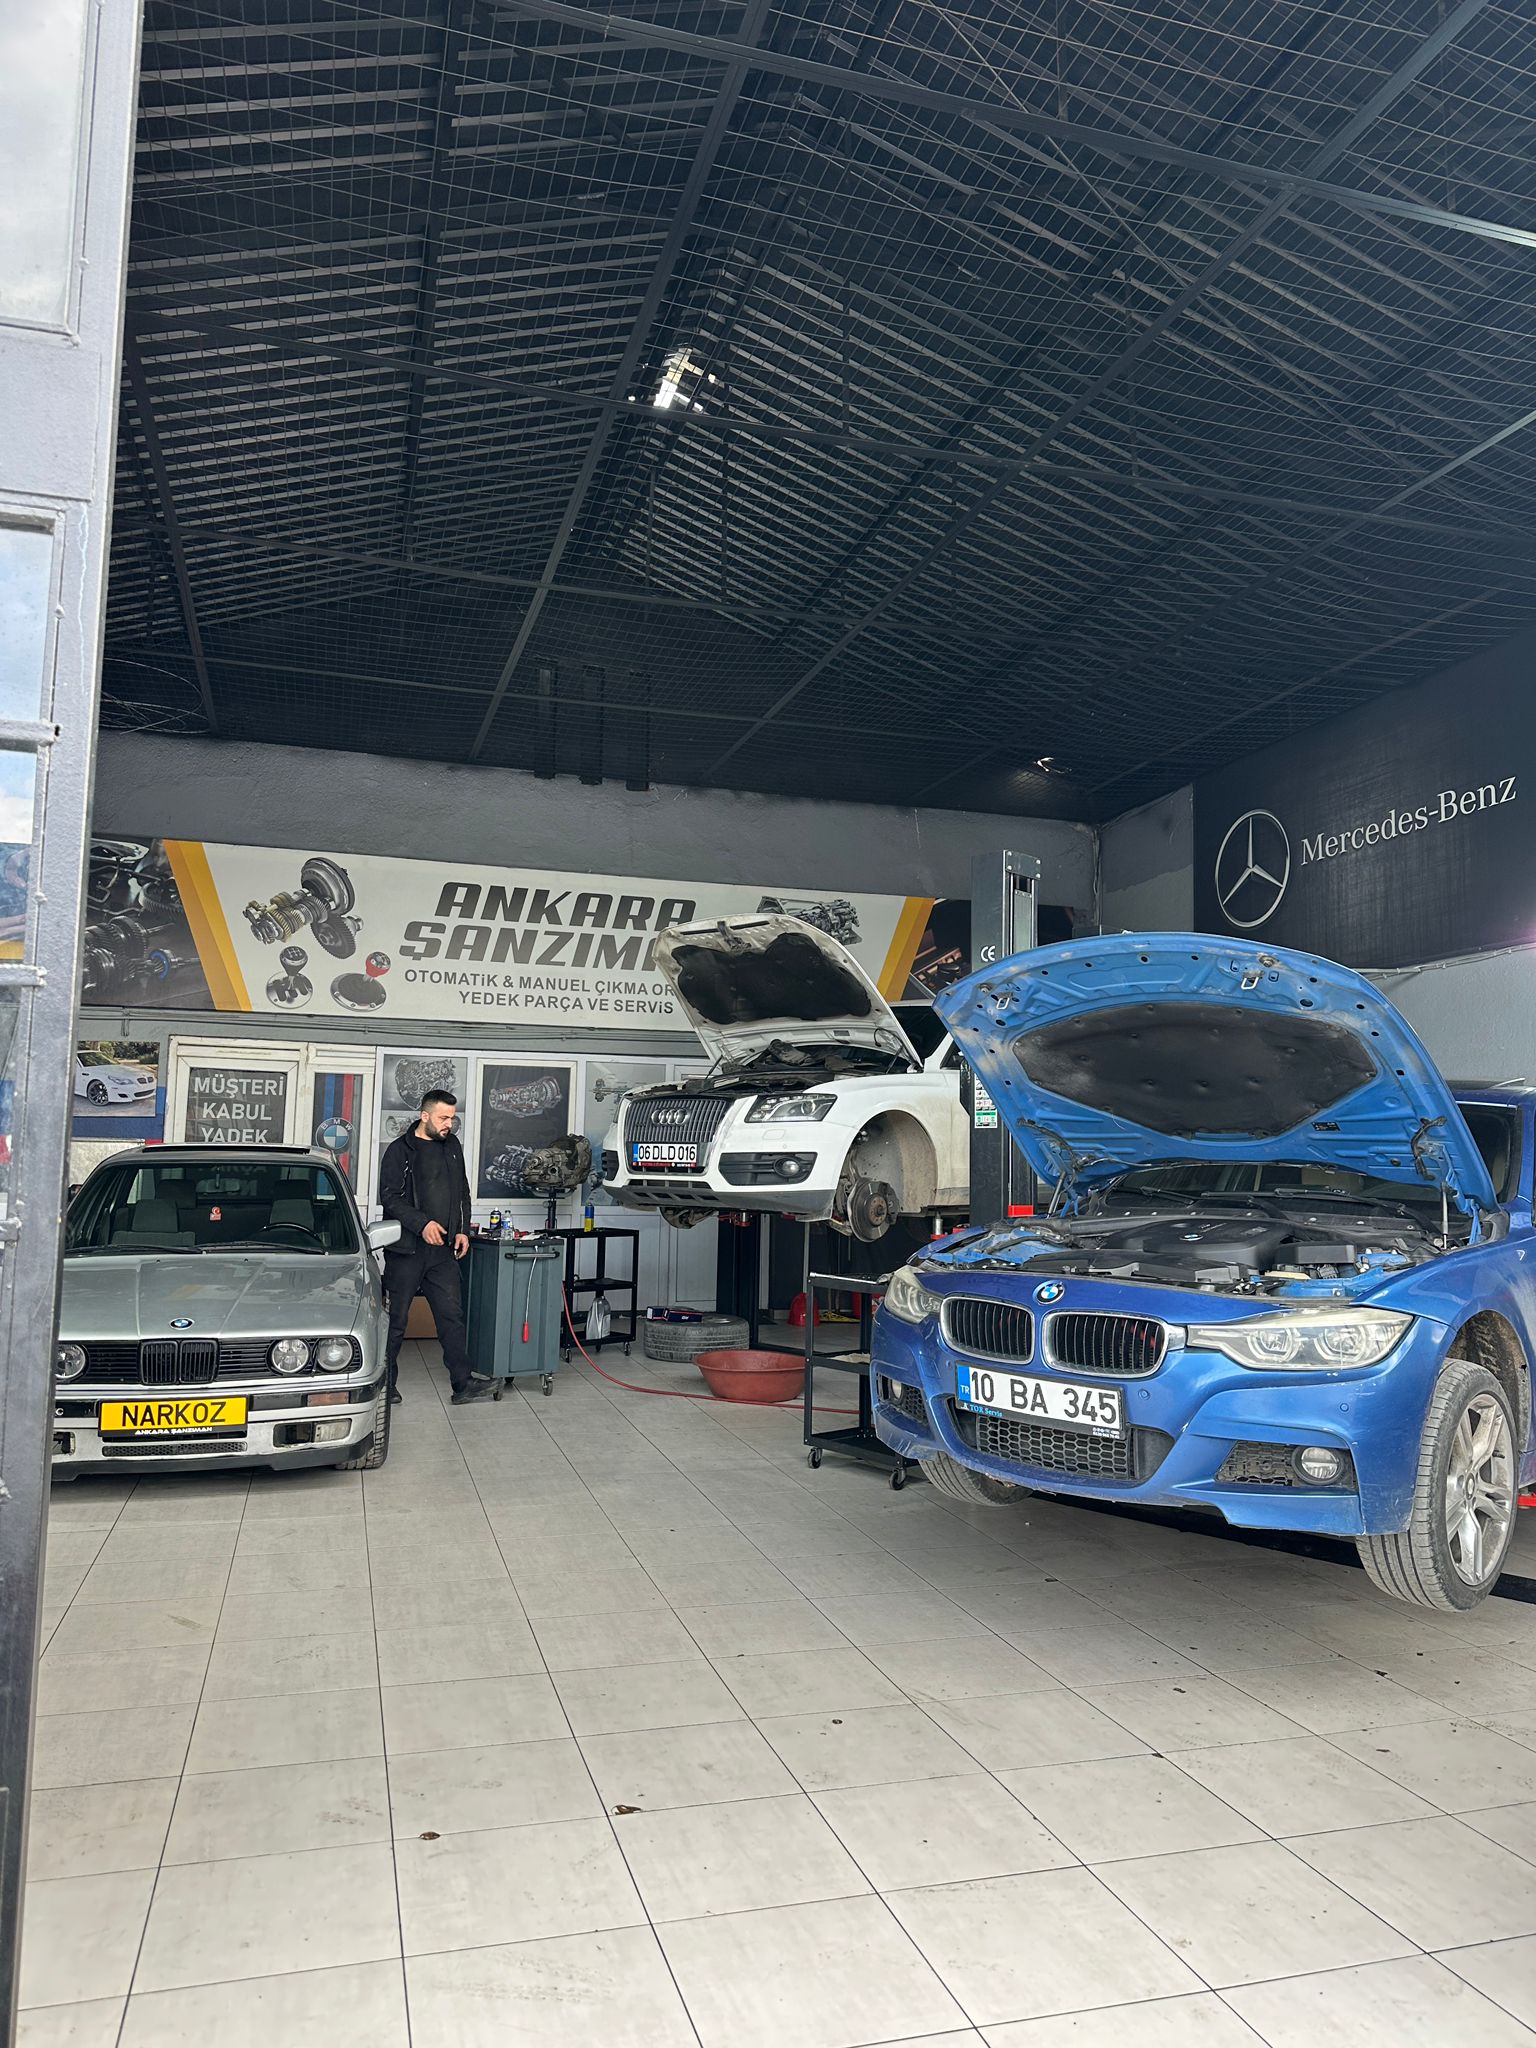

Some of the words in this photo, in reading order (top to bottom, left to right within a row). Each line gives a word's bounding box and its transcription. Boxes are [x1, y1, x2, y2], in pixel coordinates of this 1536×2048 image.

[1300, 776, 1517, 866] Mercedes-Benz
[434, 881, 697, 932] ANKARA
[502, 975, 514, 989] &
[519, 976, 590, 993] MANUEL
[595, 980, 648, 997] ÇIKMA
[459, 991, 519, 1007] YEDEK
[525, 995, 583, 1012] PARÇA
[588, 998, 609, 1011] VE
[194, 1073, 284, 1098] MÜŞTERİ
[202, 1102, 272, 1120] KABUL
[202, 1127, 269, 1143] YADEK
[639, 1146, 651, 1160] 06
[653, 1146, 676, 1160] DLD
[678, 1146, 696, 1160] 016
[960, 1384, 970, 1395] TR
[971, 1371, 995, 1403] 10
[1010, 1378, 1049, 1414] BA
[1063, 1388, 1117, 1425] 345
[121, 1401, 227, 1427] NARKOZ
[134, 1428, 170, 1436] ANKARA
